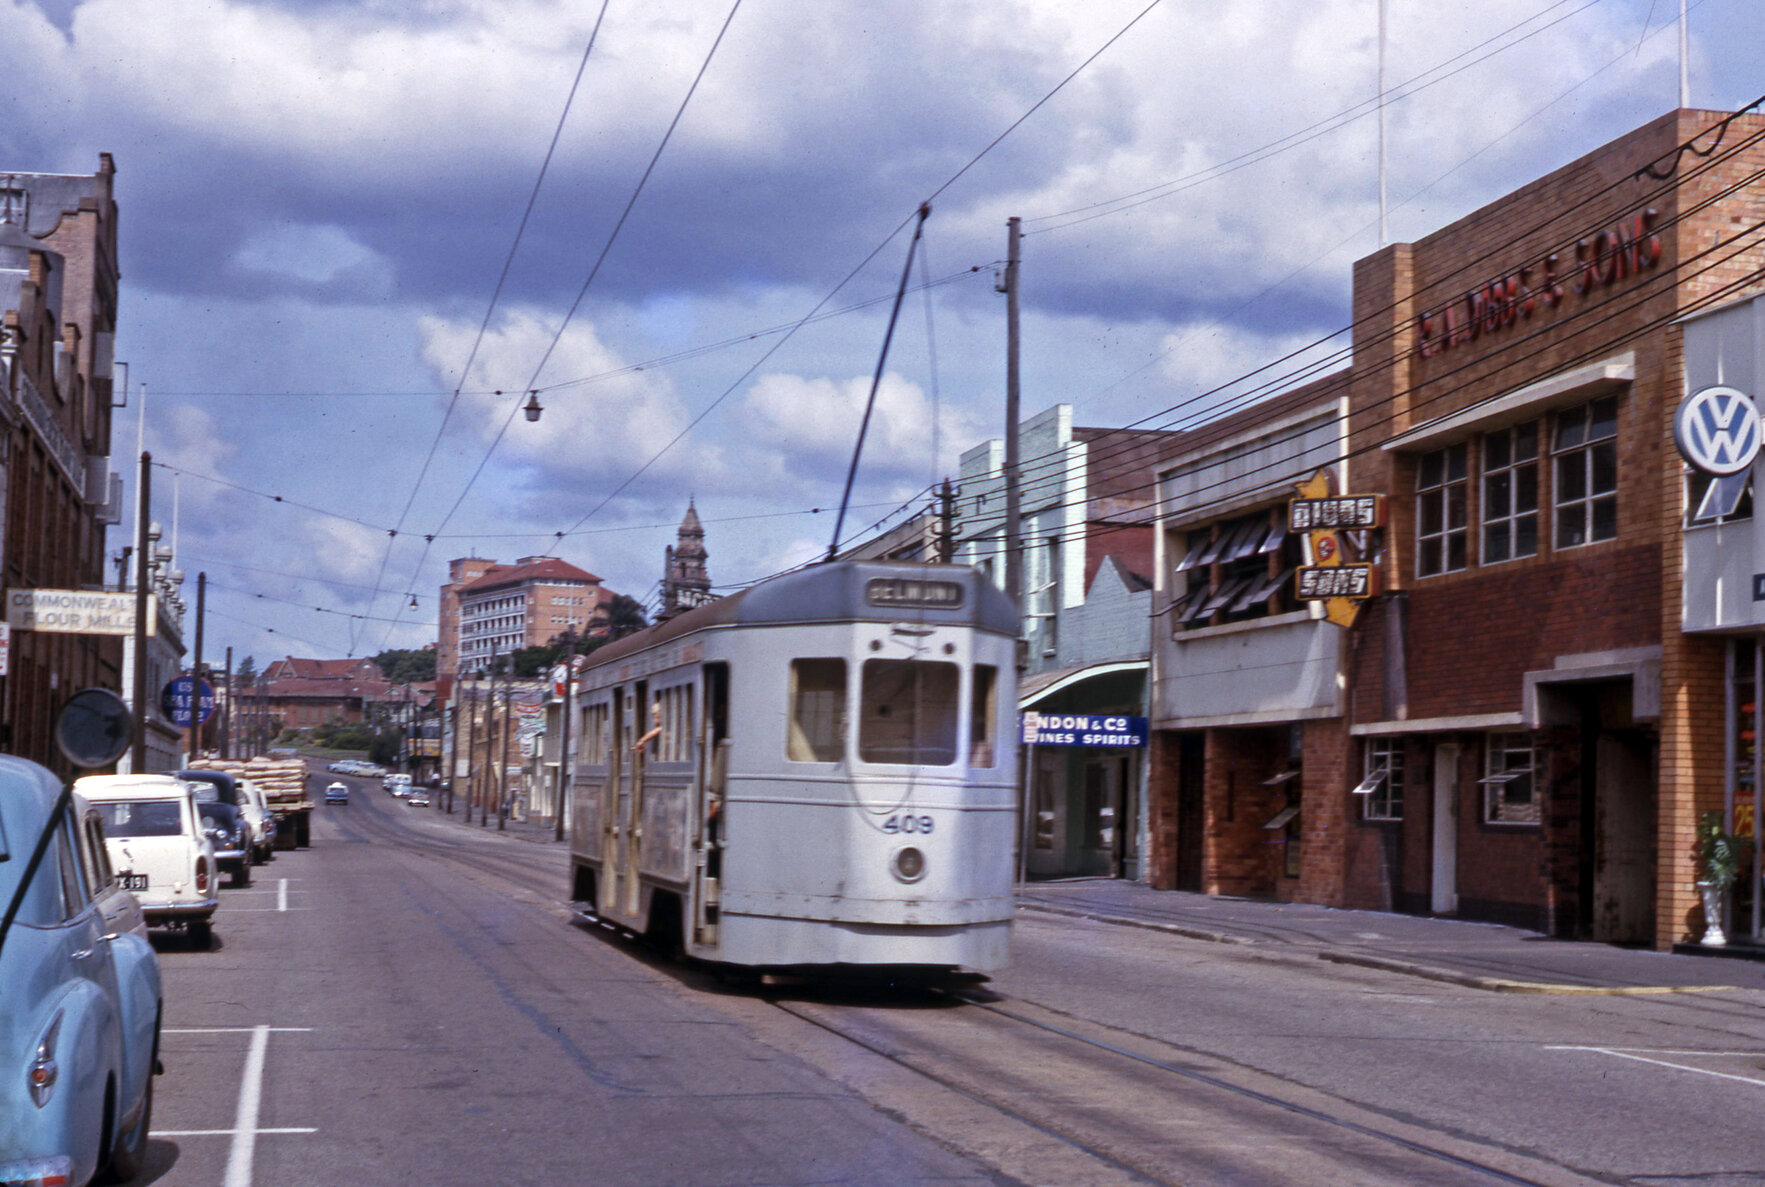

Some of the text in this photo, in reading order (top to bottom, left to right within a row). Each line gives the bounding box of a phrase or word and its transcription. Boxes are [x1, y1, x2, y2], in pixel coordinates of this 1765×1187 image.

[1571, 208, 1663, 296] SONS
[1690, 394, 1756, 466] VW
[1300, 568, 1369, 596] SONS
[12, 592, 137, 611] COMMONWEALT
[23, 612, 81, 626] FLOUR
[1038, 716, 1089, 730] NDON
[1091, 720, 1103, 730] &
[1082, 735, 1141, 745] SPIRITS
[882, 814, 935, 835] 409
